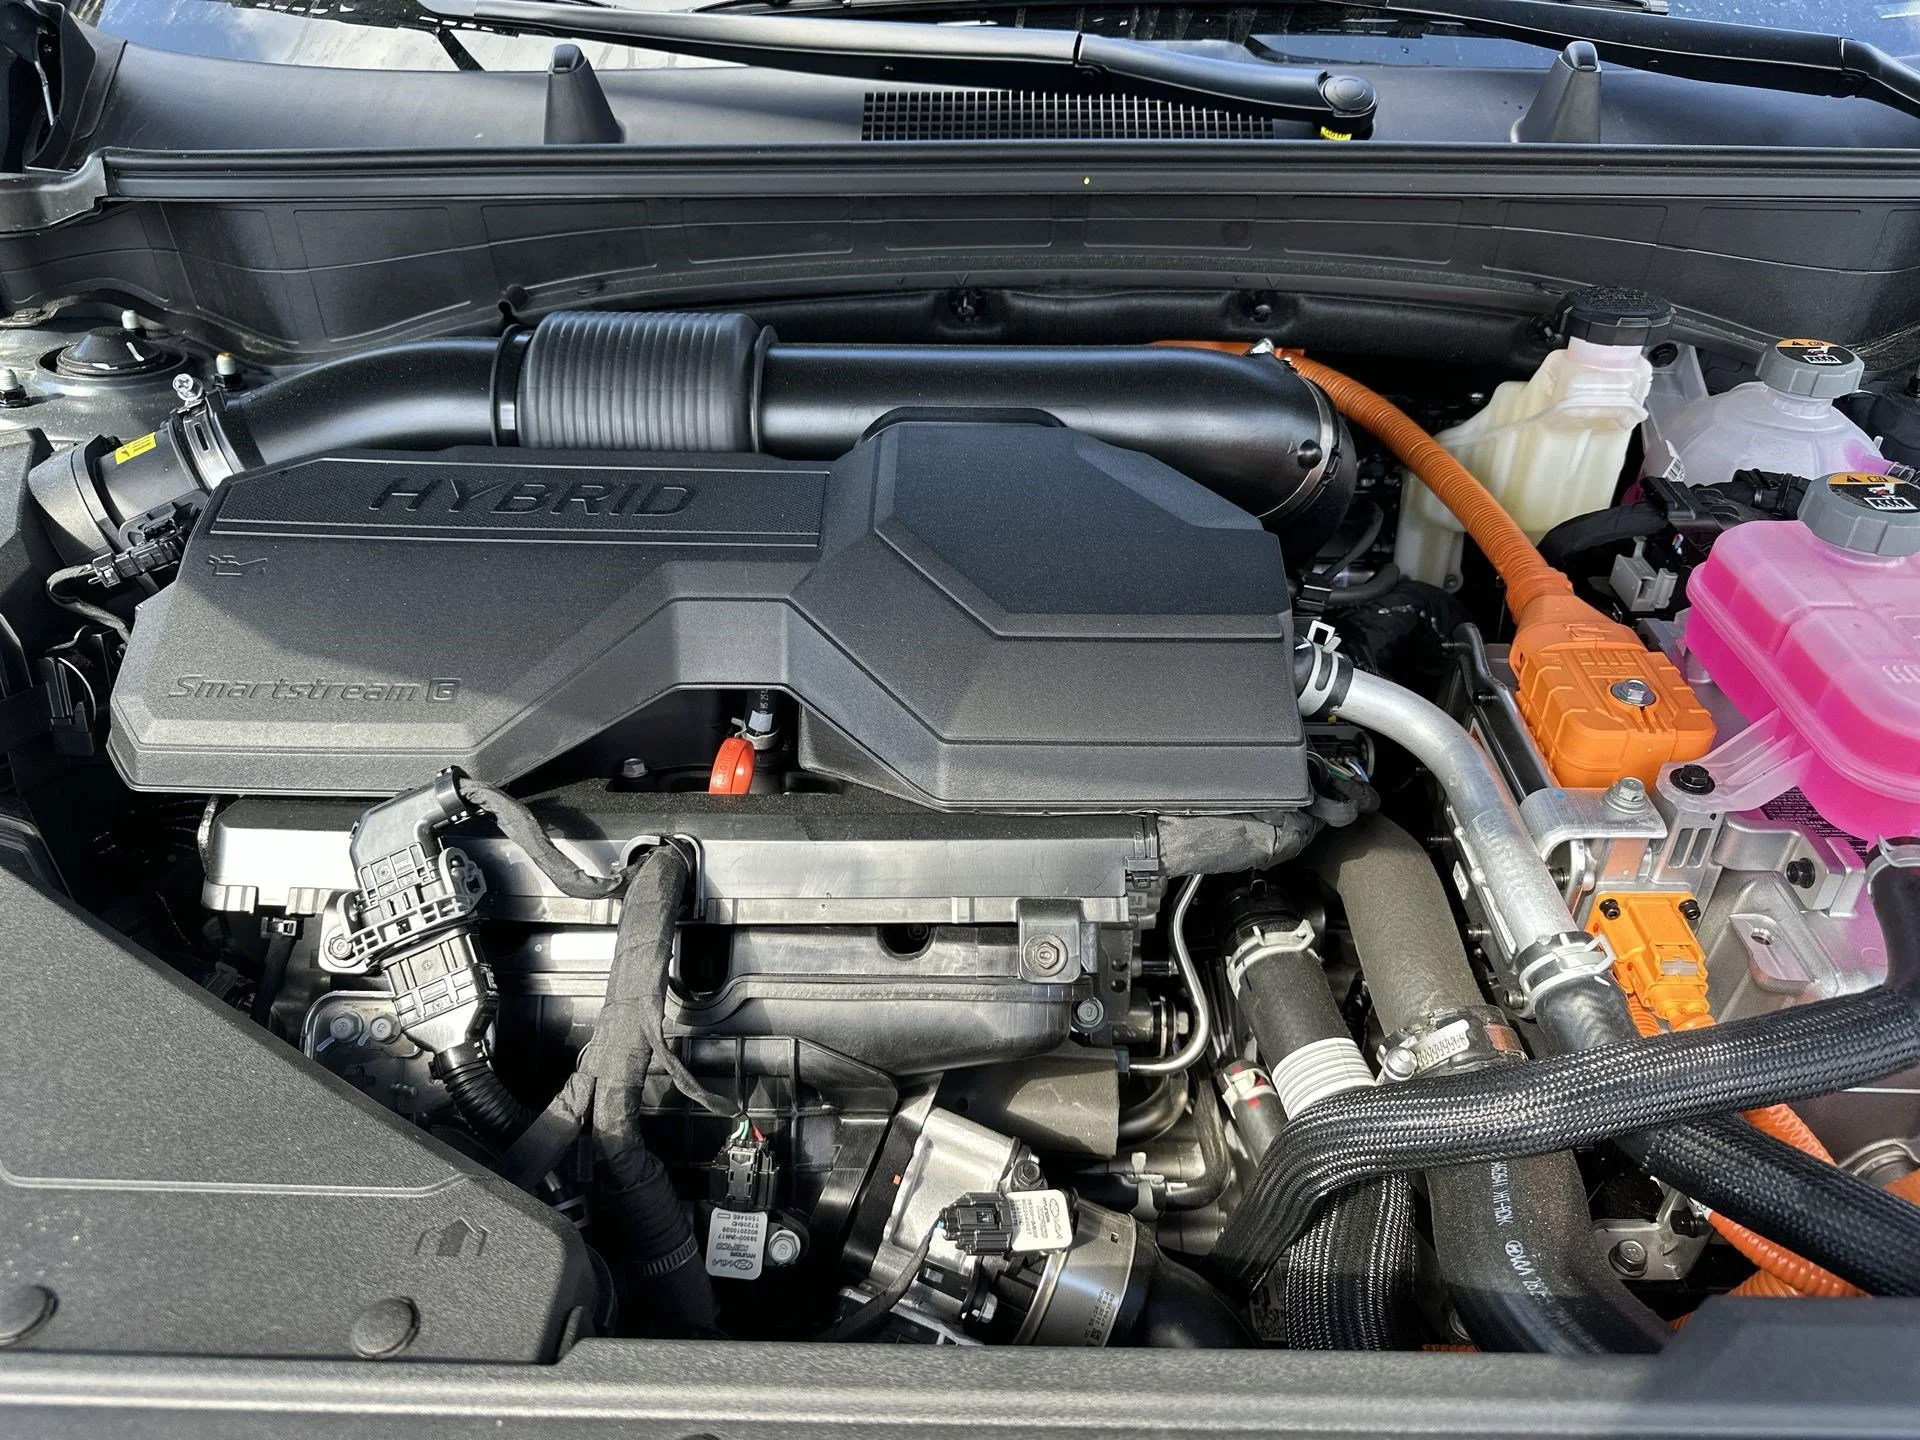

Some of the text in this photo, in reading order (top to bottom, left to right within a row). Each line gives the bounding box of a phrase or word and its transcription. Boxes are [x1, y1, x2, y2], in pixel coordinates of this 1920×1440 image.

[368, 477, 699, 517] HYBRID
[168, 674, 461, 702] Smartstream G
